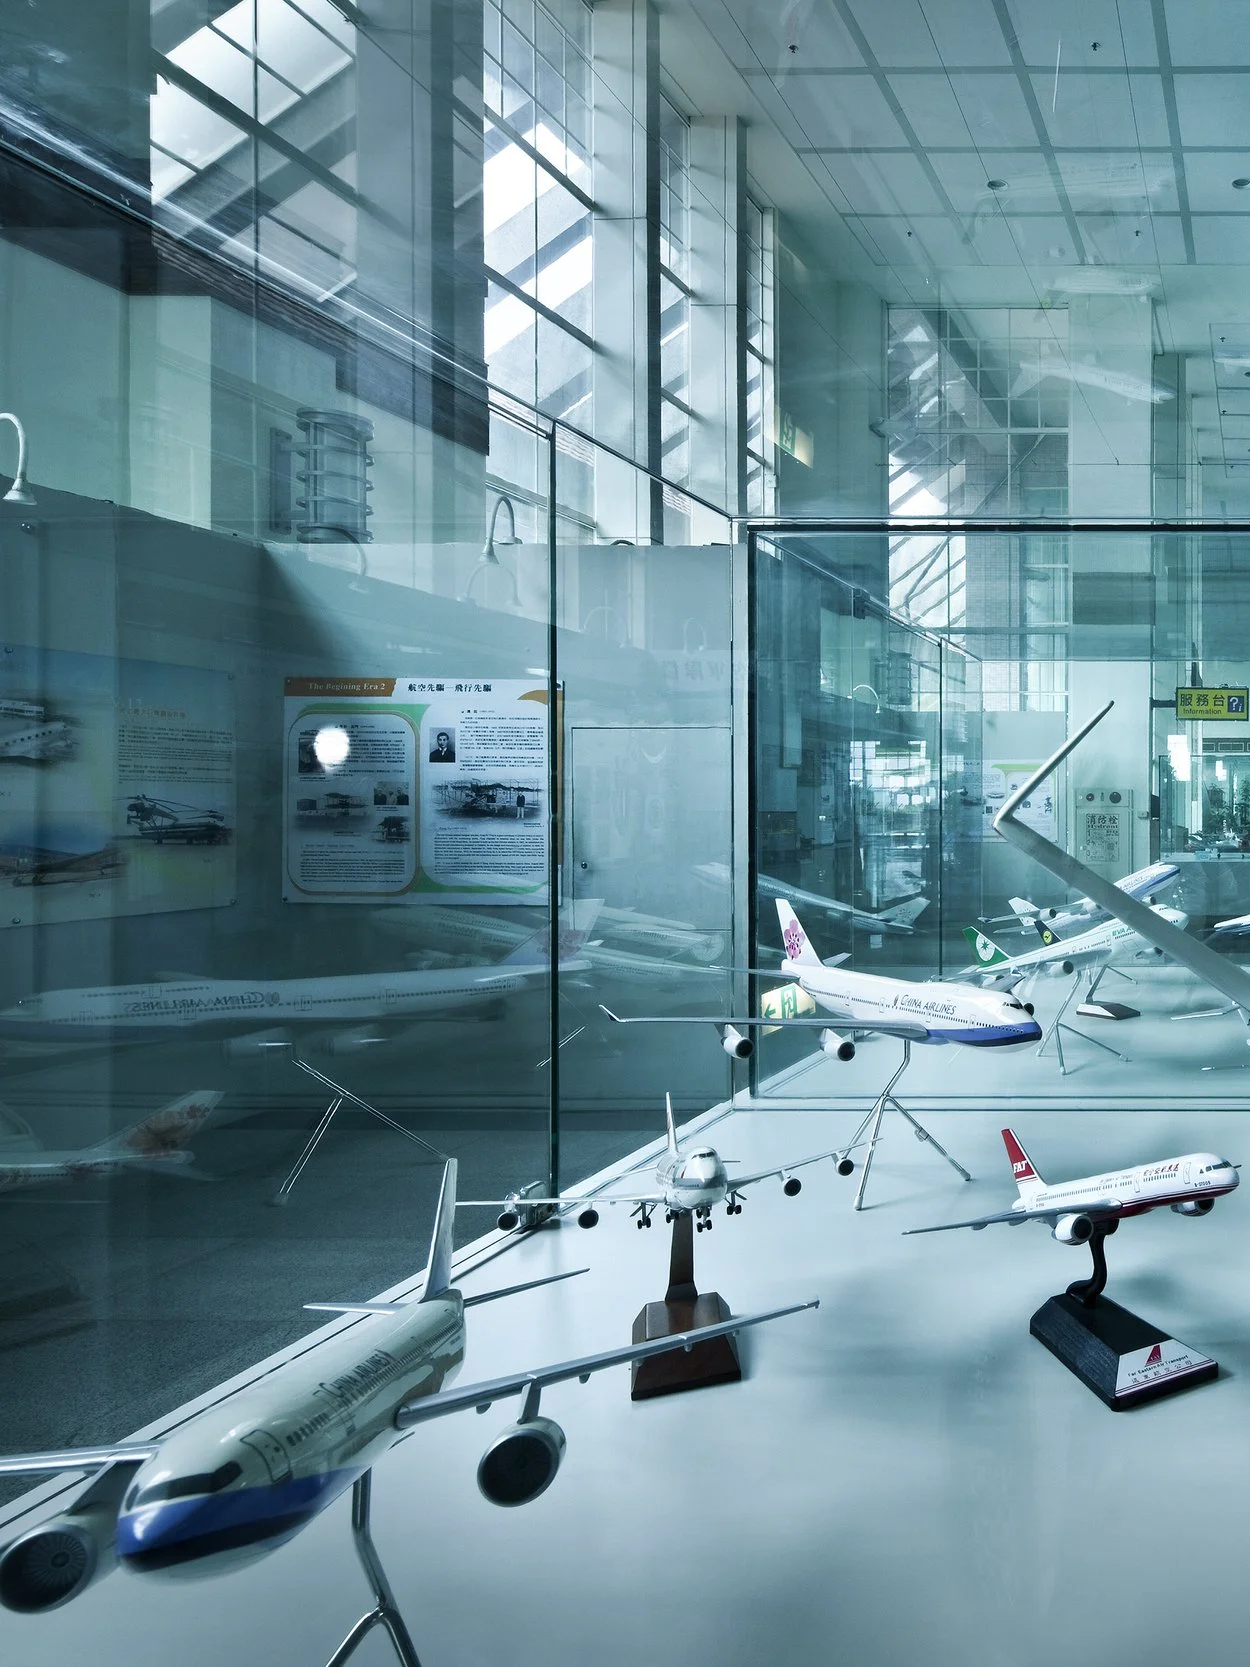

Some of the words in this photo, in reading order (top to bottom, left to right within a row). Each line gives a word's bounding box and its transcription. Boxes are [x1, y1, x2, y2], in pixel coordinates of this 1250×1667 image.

[308, 682, 324, 690] The
[1180, 693, 1225, 707] 服務台
[1087, 815, 1118, 825] 消防栓
[1112, 927, 1126, 937] EVA
[900, 994, 921, 1008] CHINA
[923, 1001, 957, 1015] AIRLINES
[1012, 1160, 1028, 1173] FAT
[1137, 1364, 1157, 1374] Eastern
[1156, 1361, 1165, 1369] Air
[1165, 1354, 1189, 1367] Transport
[319, 1374, 362, 1398] CHINA
[352, 1349, 398, 1379] AIRLINES
